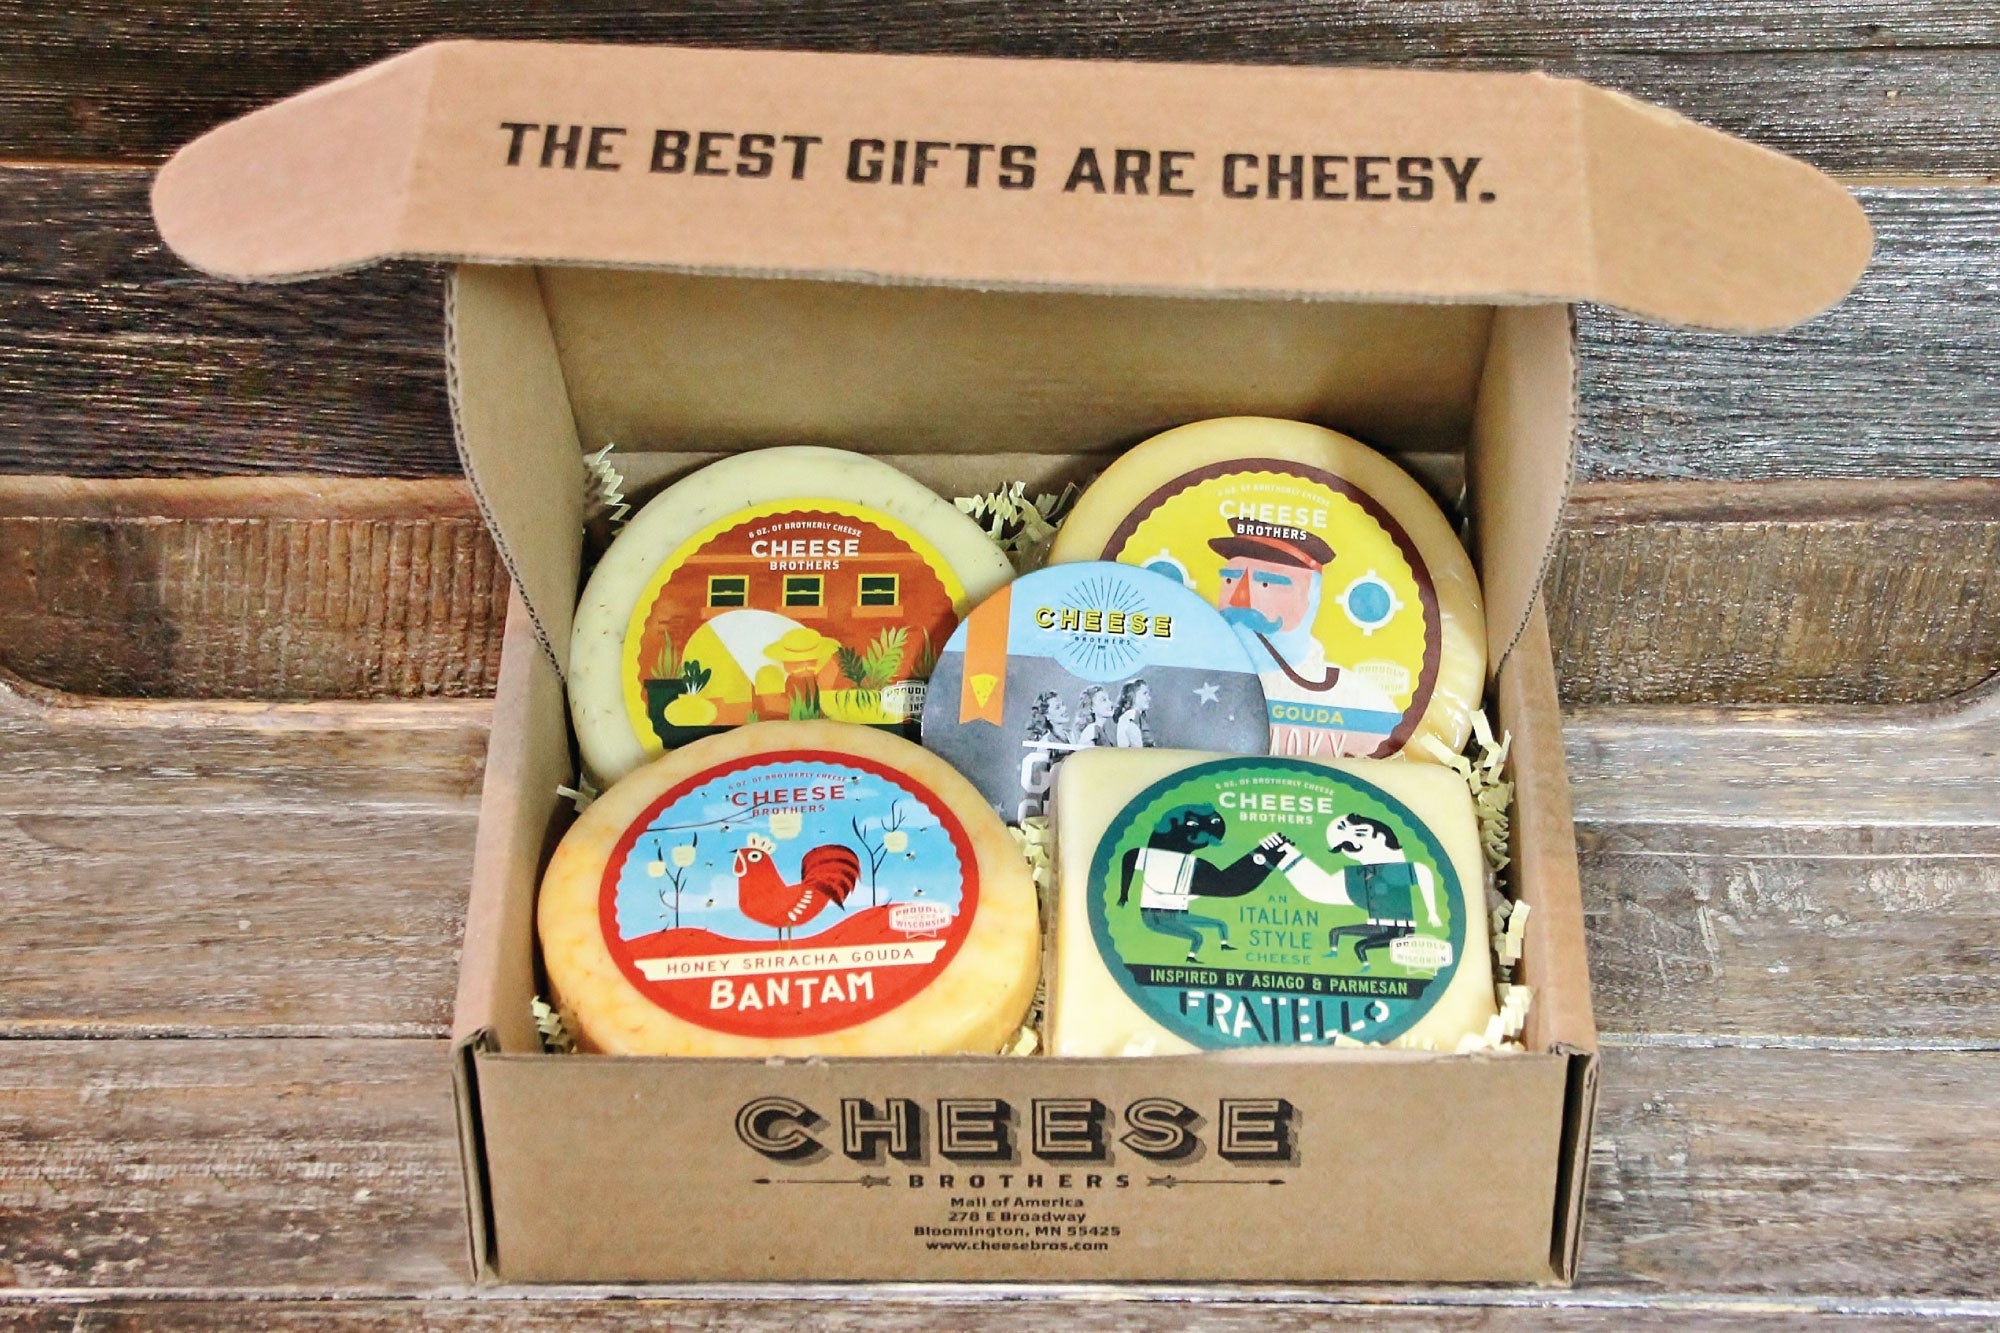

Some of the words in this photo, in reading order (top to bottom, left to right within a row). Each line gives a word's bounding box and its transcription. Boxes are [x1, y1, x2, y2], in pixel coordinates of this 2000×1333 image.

[500, 122, 627, 172] THE
[648, 128, 823, 181] BEST
[845, 138, 1037, 190] GIFTS
[1062, 147, 1195, 198] ARE
[1222, 153, 1498, 203] CHEESY.
[1219, 499, 1328, 529] CHEESE
[772, 524, 783, 532] OF
[784, 521, 832, 530] BROTHERLY
[833, 523, 863, 538] CHEESE
[1236, 523, 1307, 541] BROTHERS
[751, 539, 860, 558] CHEESE
[769, 560, 840, 571] BROTHERS
[1035, 606, 1172, 638] CHEESE
[1074, 636, 1131, 646] BROTHERS
[1271, 704, 1345, 725] GOUDA
[765, 771, 814, 781] BROTHERLY
[816, 772, 847, 783] CHEESE
[1252, 777, 1302, 787] BROTHERLY
[1304, 782, 1335, 796] CHEESE
[731, 785, 845, 807] CHEESE
[1218, 791, 1334, 815] CHEESE
[752, 803, 826, 818] BROTHERS
[1239, 811, 1313, 825] BROTHERS
[1268, 895, 1287, 903] AN
[1239, 906, 1319, 927] ITALIAN
[1249, 929, 1313, 950] STYLE
[667, 959, 730, 974] HONEY
[743, 953, 839, 970] SRIRACHA
[851, 948, 914, 963] GOUDA
[1245, 952, 1312, 966] CHEESE
[709, 971, 875, 1012] BANTAM
[1150, 969, 1218, 986] INSPIRED
[1226, 973, 1244, 987] BY
[1252, 975, 1305, 990] ASIAGO
[1312, 977, 1322, 991] &
[1330, 978, 1408, 995] PARMESAN
[1179, 991, 1390, 1043] FRATELLO
[735, 1097, 1300, 1167] CHEESE
[909, 1174, 1130, 1189] BROTHERS
[950, 1197, 986, 1208] Mall
[992, 1197, 1009, 1208] of
[1014, 1197, 1084, 1208] America
[948, 1212, 980, 1222] 278
[986, 1212, 996, 1222] E
[1001, 1212, 1086, 1223] Broadway
[914, 1226, 1030, 1237] Bloomington,
[1035, 1226, 1061, 1236] MN
[1067, 1226, 1121, 1236] 55425
[926, 1240, 1109, 1250] www.cheesebros.com
